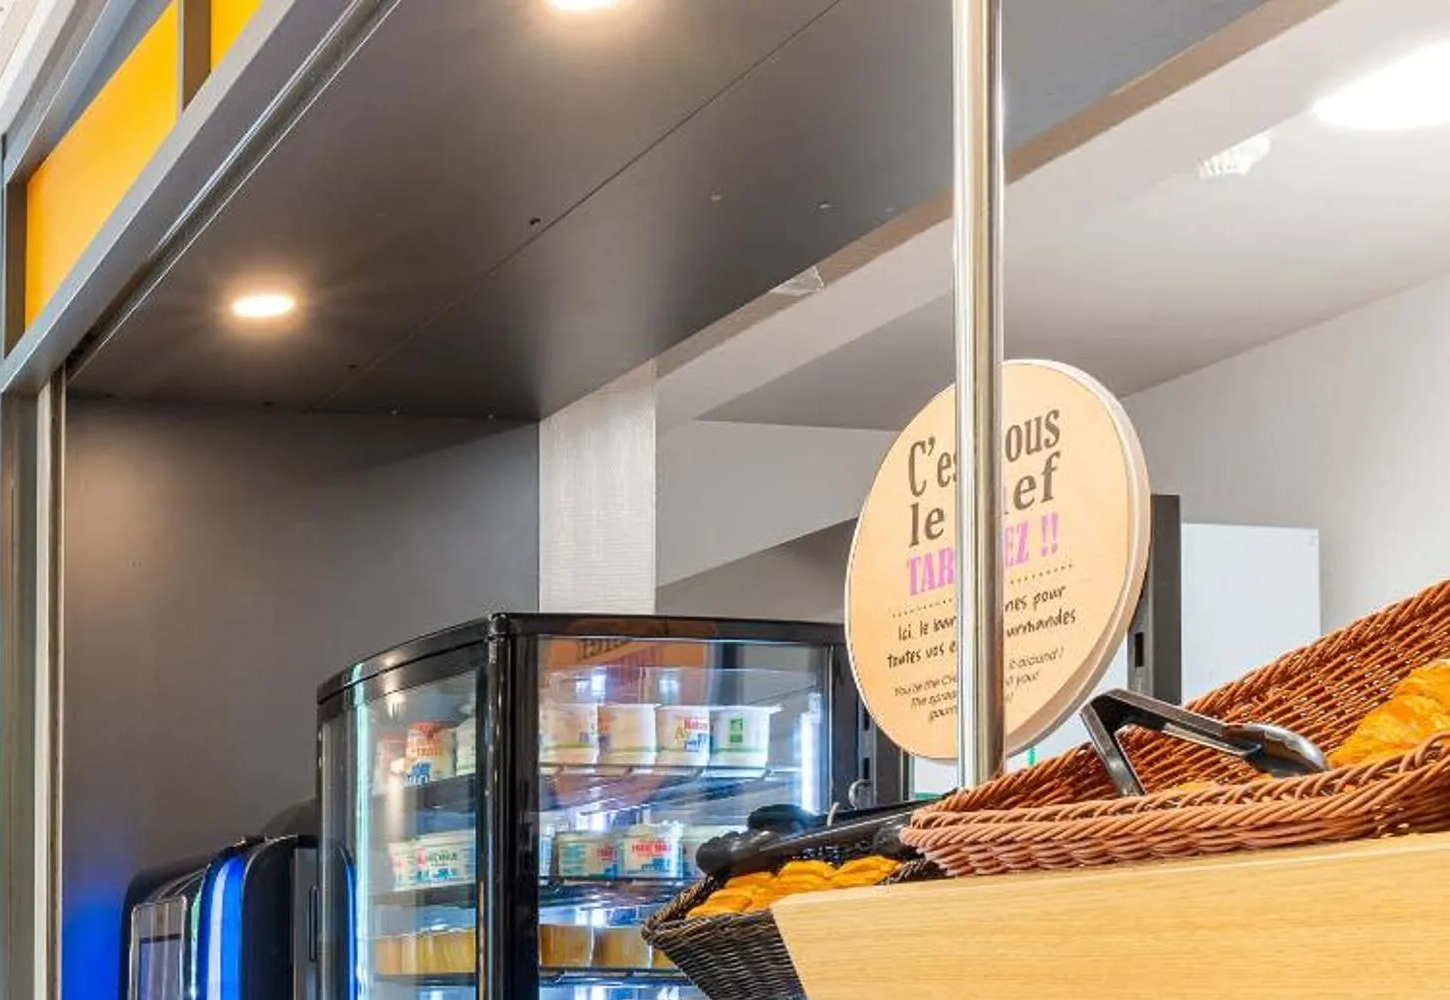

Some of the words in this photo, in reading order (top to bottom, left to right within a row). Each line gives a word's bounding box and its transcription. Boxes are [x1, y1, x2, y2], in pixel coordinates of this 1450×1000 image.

[1005, 409, 1061, 462] ous
[909, 502, 945, 547] le
[1033, 584, 1066, 611] pour
[887, 649, 921, 669] toutes
[926, 644, 945, 658] vos
[1006, 607, 1077, 639] urmandes
